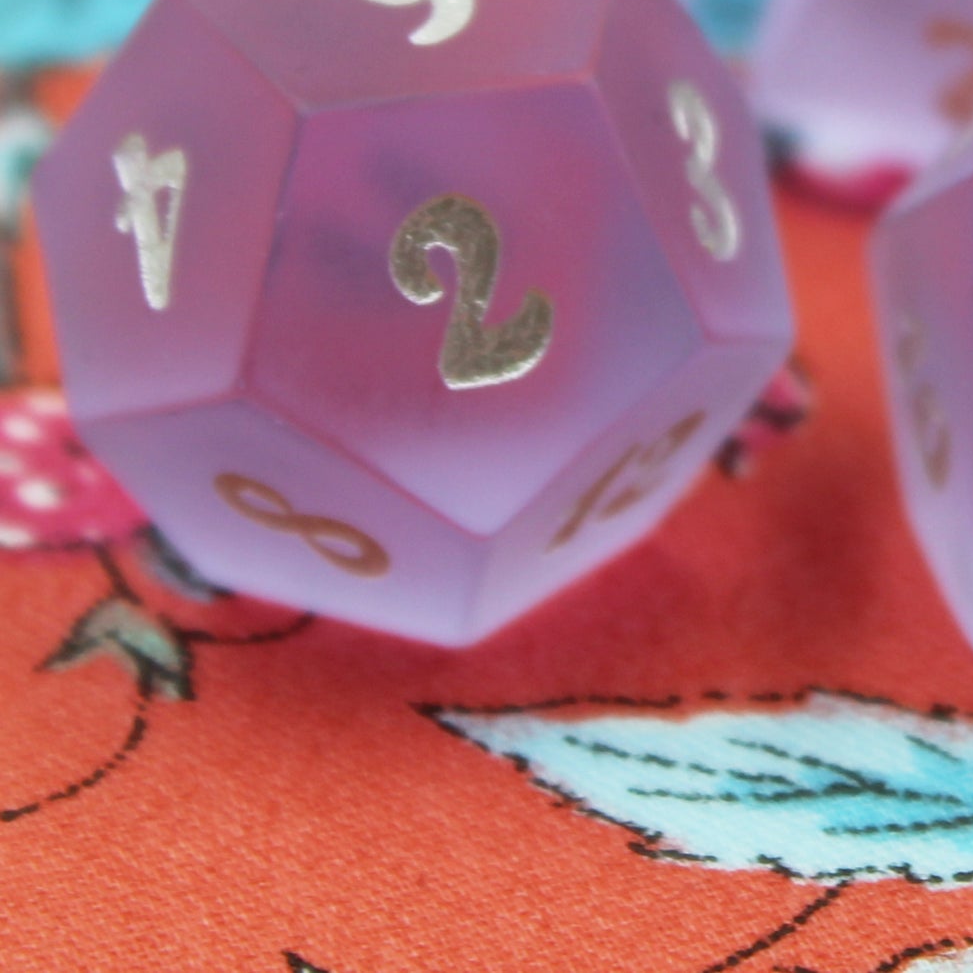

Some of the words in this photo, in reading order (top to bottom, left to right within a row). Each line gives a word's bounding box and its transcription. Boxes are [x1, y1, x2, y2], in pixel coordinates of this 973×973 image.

[113, 132, 186, 310] 4
[390, 194, 554, 390] 2
[214, 471, 390, 577] 8
